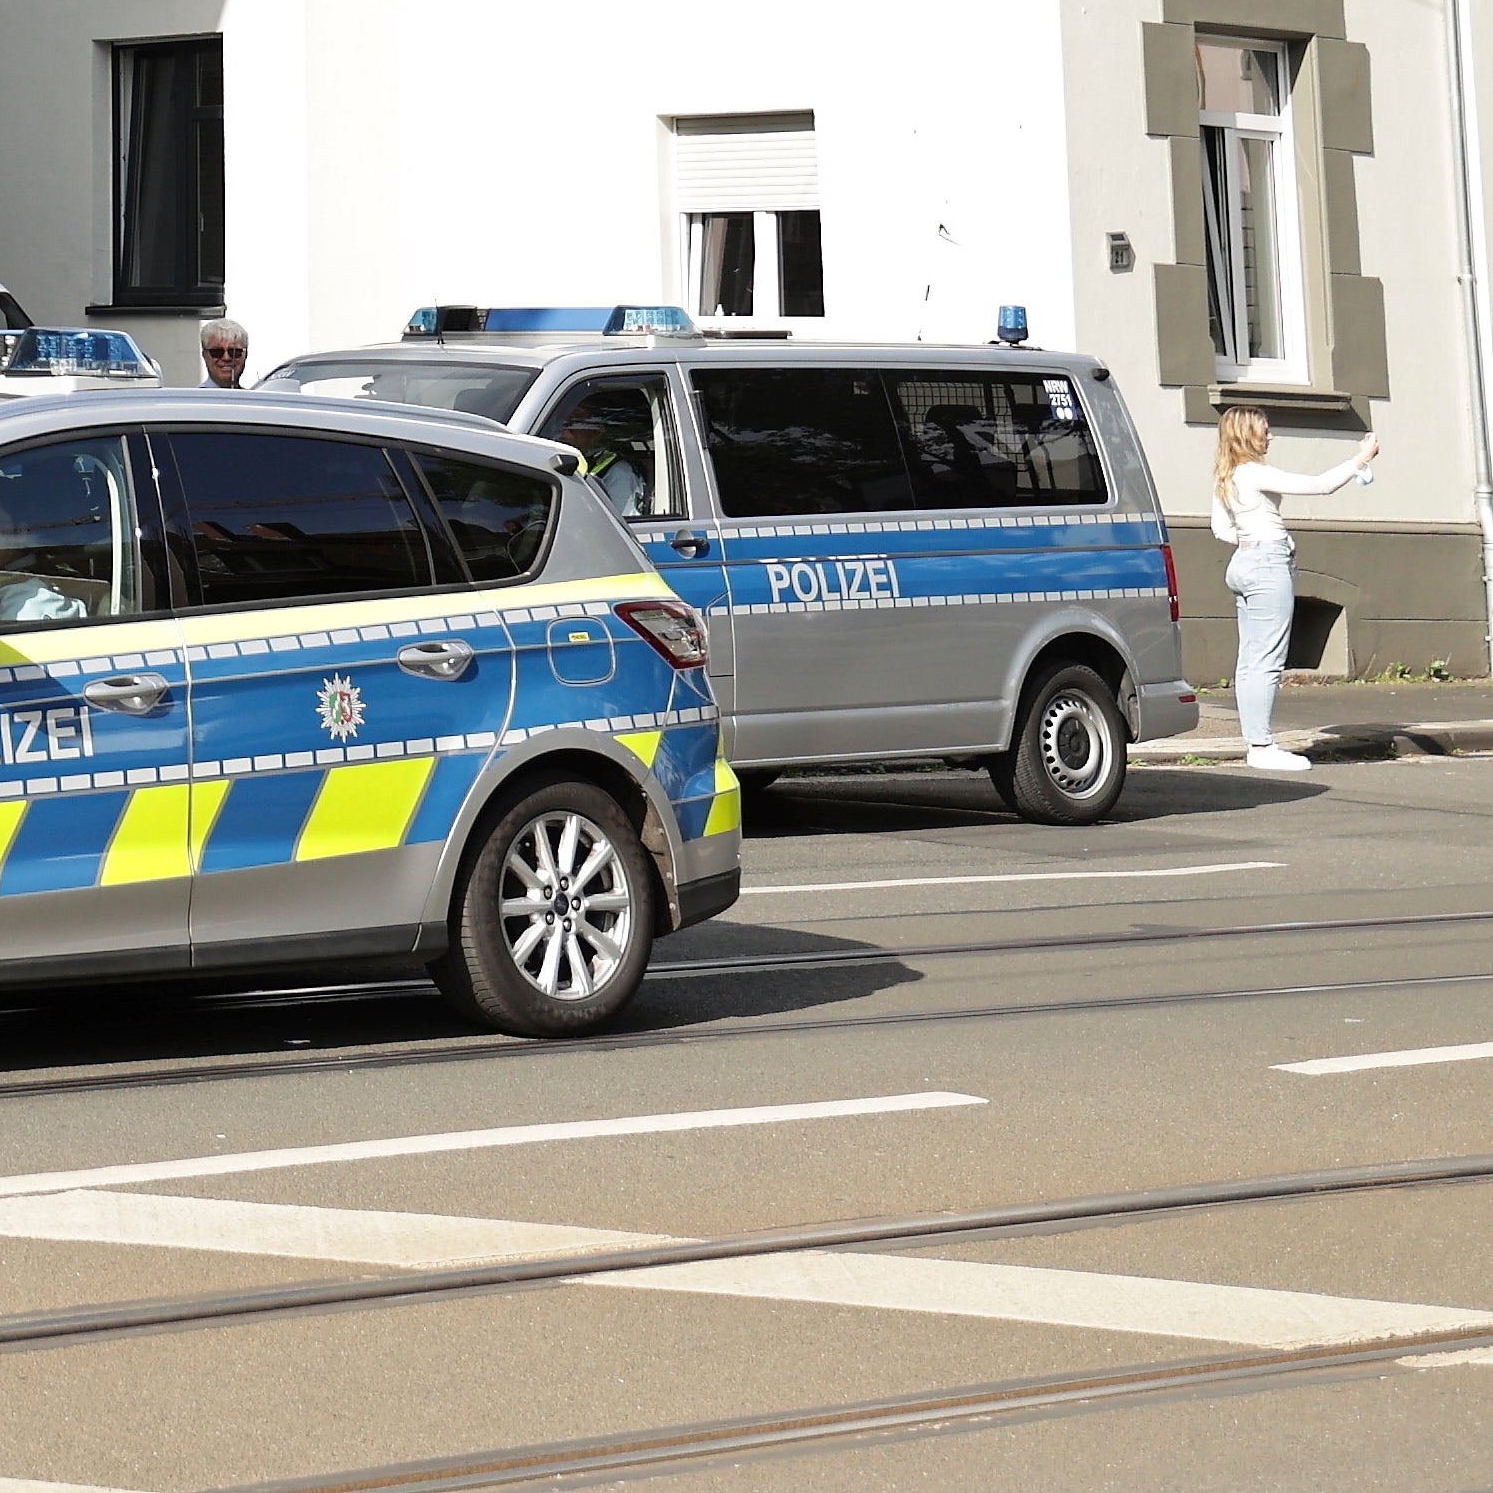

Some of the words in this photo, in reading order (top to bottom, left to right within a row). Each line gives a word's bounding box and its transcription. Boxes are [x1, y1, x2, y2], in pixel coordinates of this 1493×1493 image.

[1042, 379, 1069, 393] NRW
[1049, 393, 1073, 407] 2751
[766, 558, 901, 603] POLIZEI
